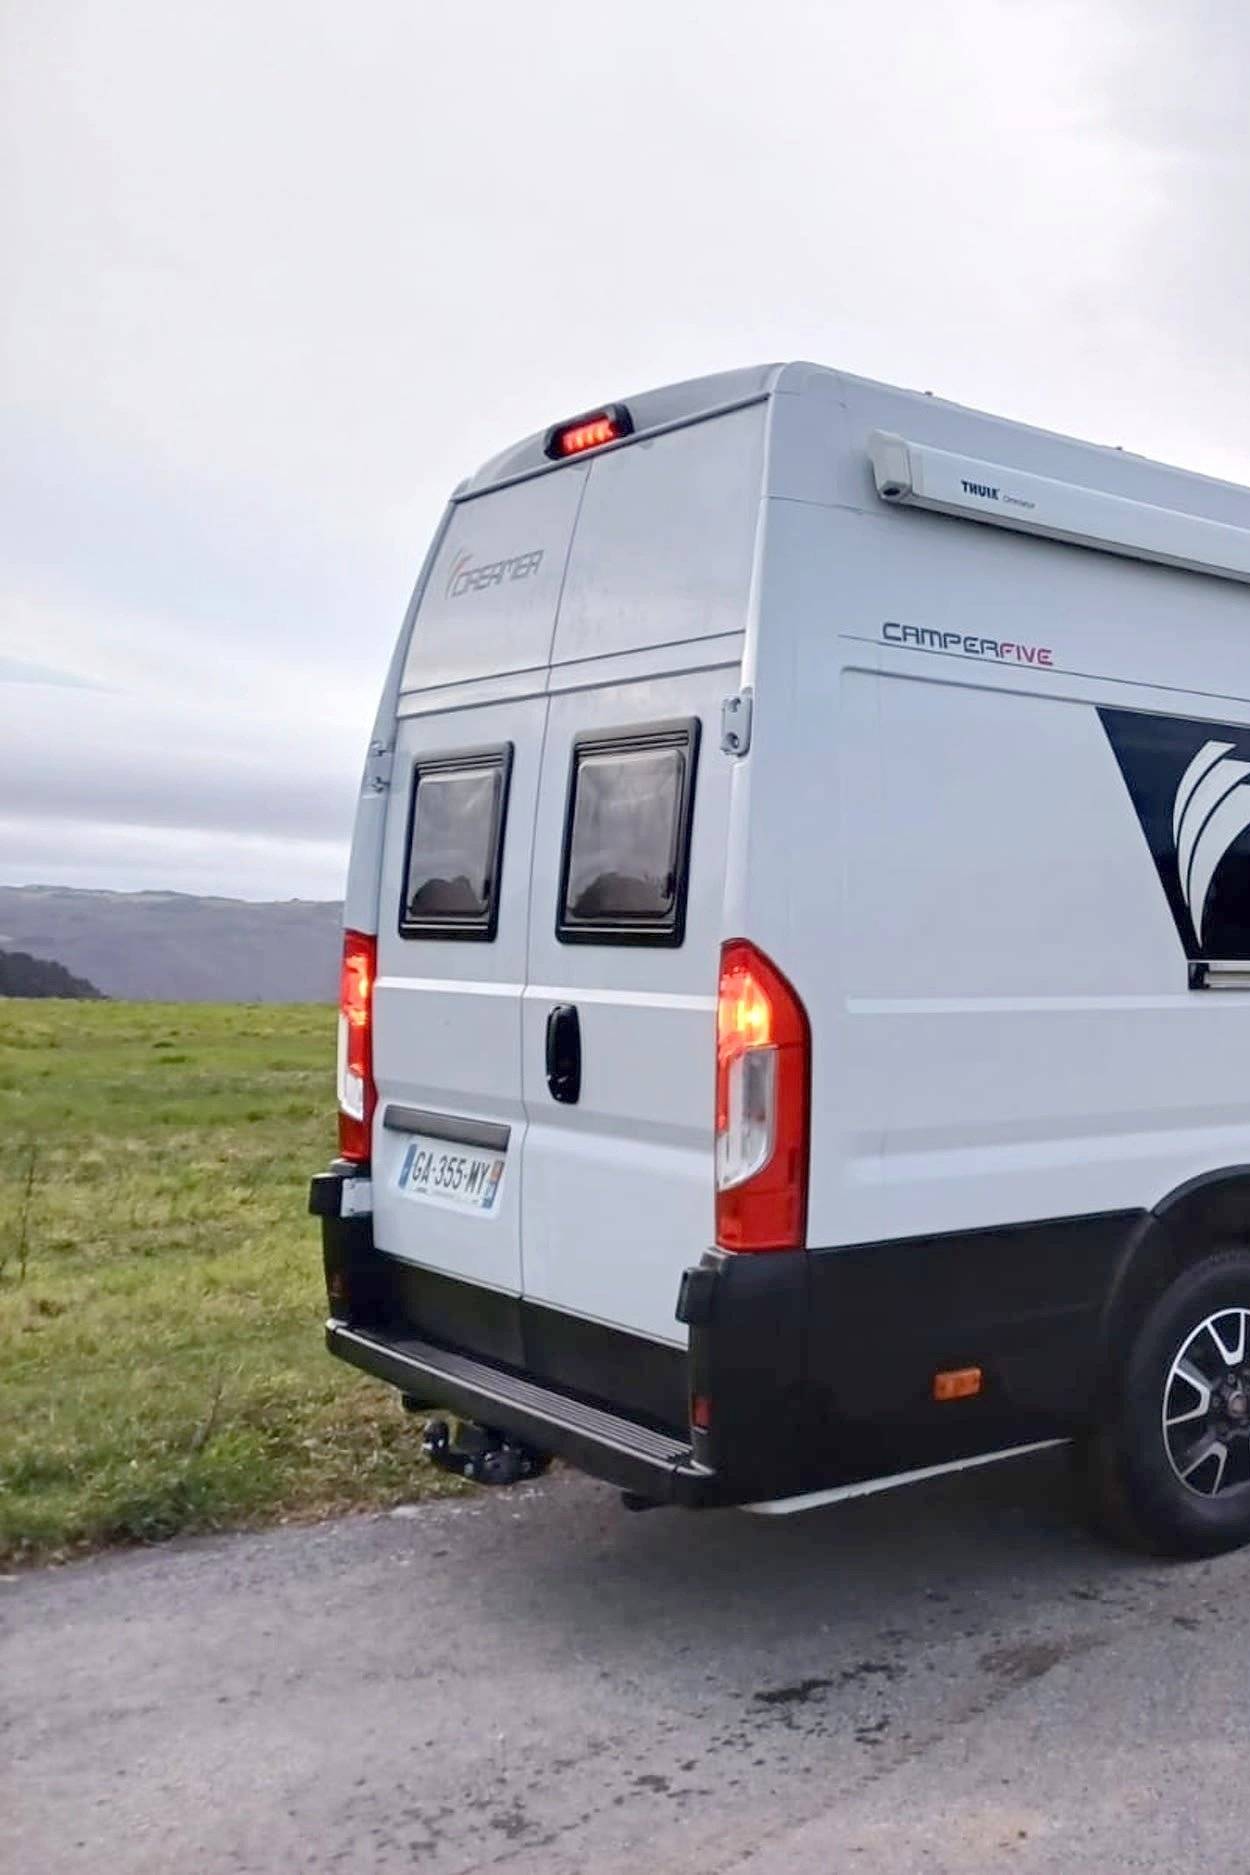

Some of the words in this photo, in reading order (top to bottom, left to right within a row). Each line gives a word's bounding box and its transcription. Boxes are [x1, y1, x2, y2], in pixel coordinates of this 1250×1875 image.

[960, 479, 1000, 500] THULE
[451, 550, 545, 597] DREAMER
[882, 622, 1053, 666] CAMPERFIVE
[411, 1151, 491, 1195] GA-355-MY
